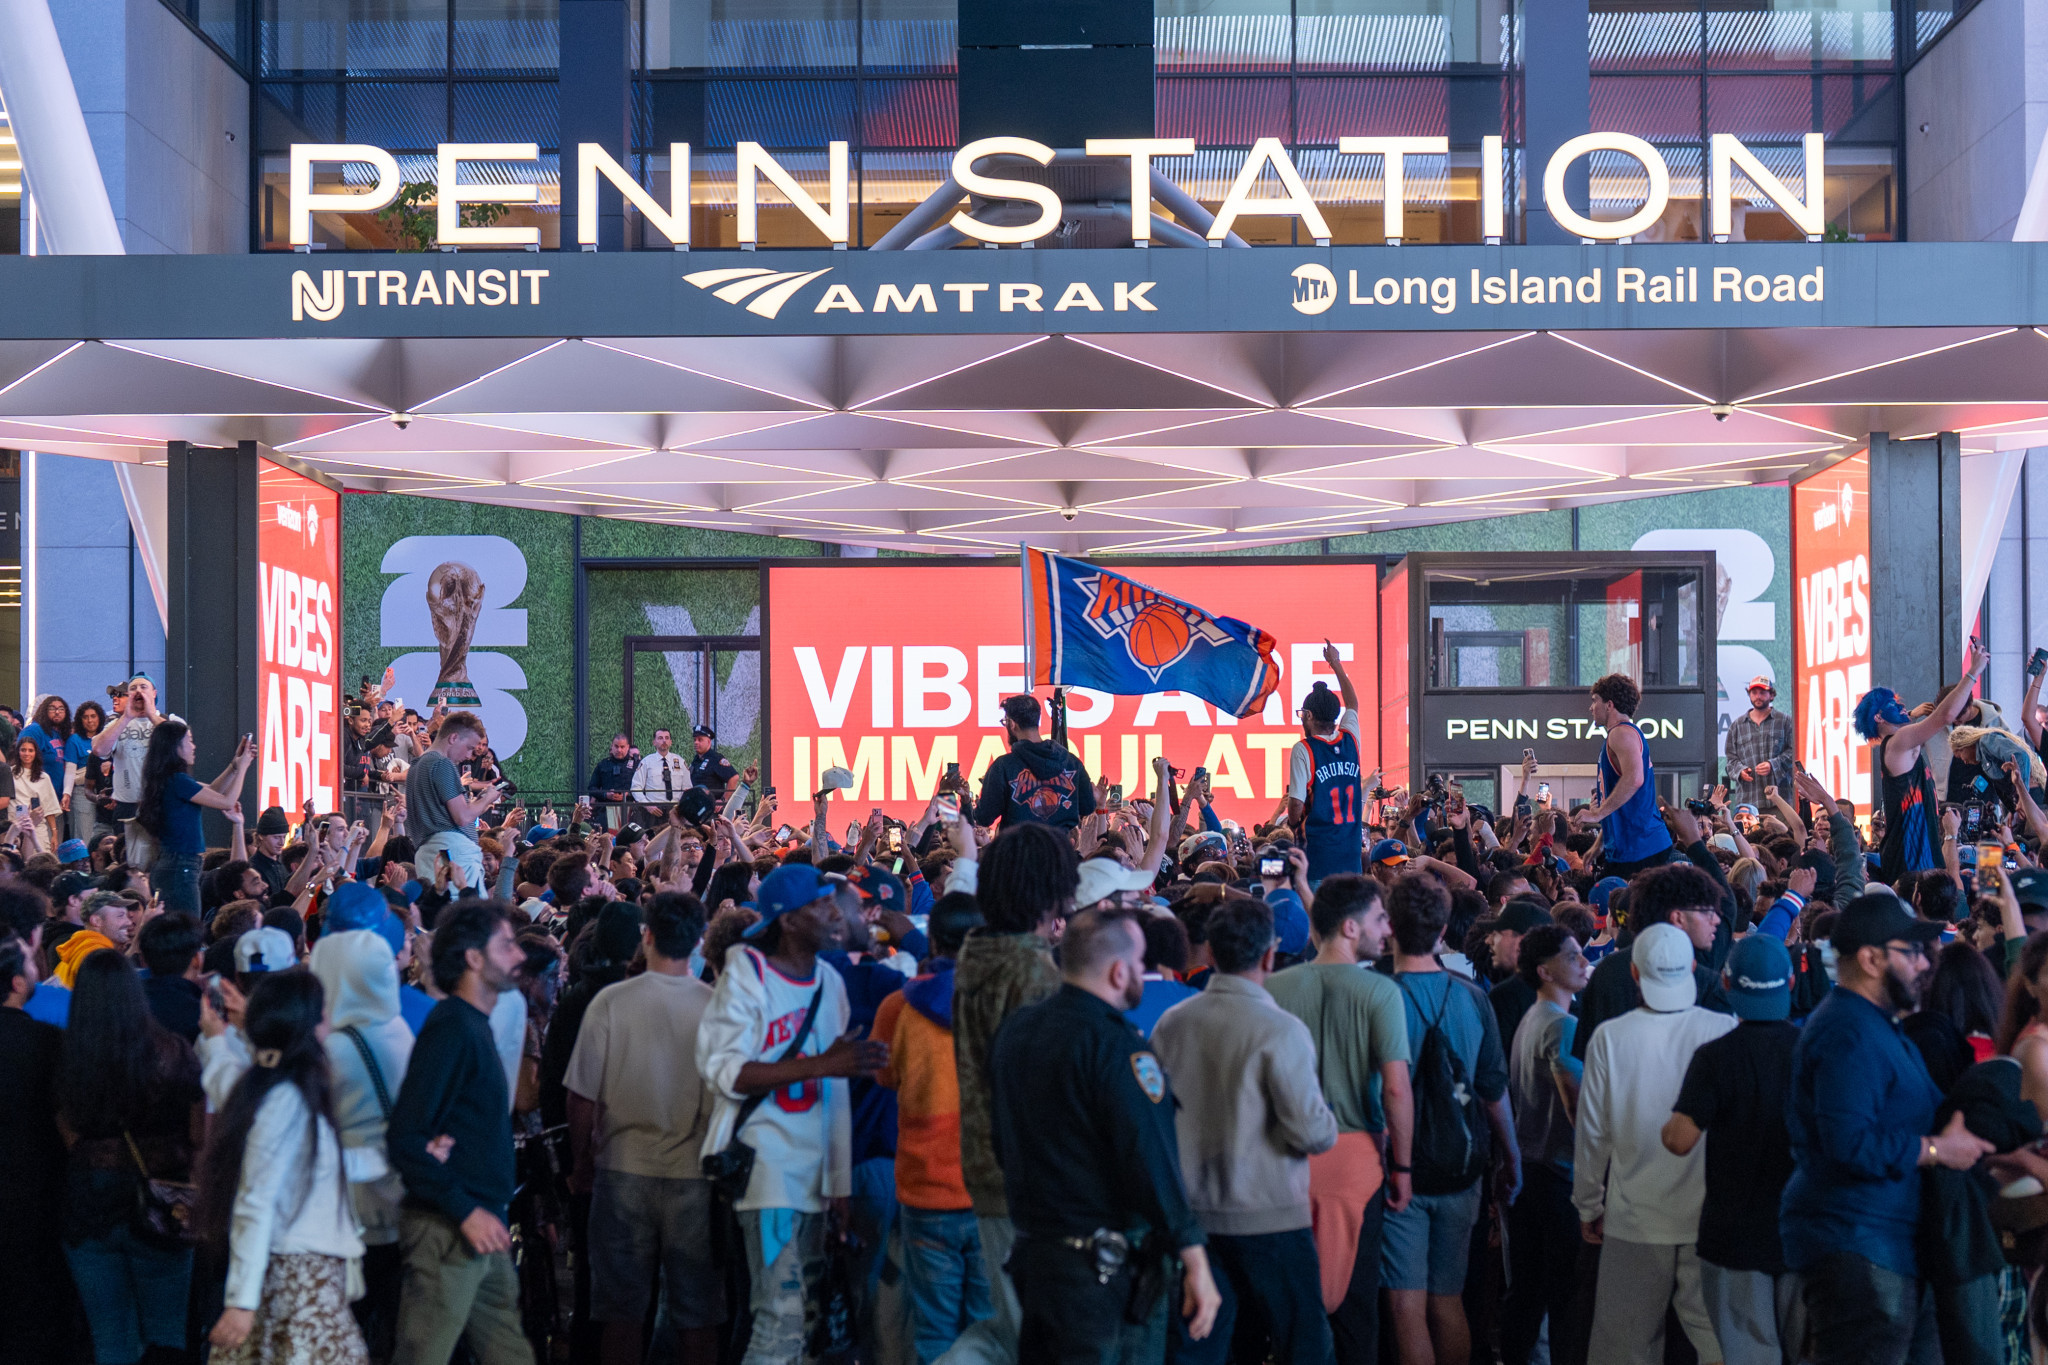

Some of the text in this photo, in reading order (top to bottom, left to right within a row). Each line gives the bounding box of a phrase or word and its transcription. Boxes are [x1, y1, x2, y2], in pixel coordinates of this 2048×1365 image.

[290, 132, 1825, 245] PENN STATION
[291, 268, 550, 321] NJ TRANSIT
[813, 282, 1159, 313] AMTRAK
[1292, 266, 1825, 314] MTA Long Island Rail Road
[260, 561, 333, 677] VIBES
[1801, 555, 1869, 669] VIBES
[260, 672, 333, 815] ARE
[1447, 718, 1684, 740] PENN STAON
[1808, 662, 1871, 806] ARE
[793, 734, 1301, 801] IMMAULAT
[1330, 785, 1355, 824] 11
